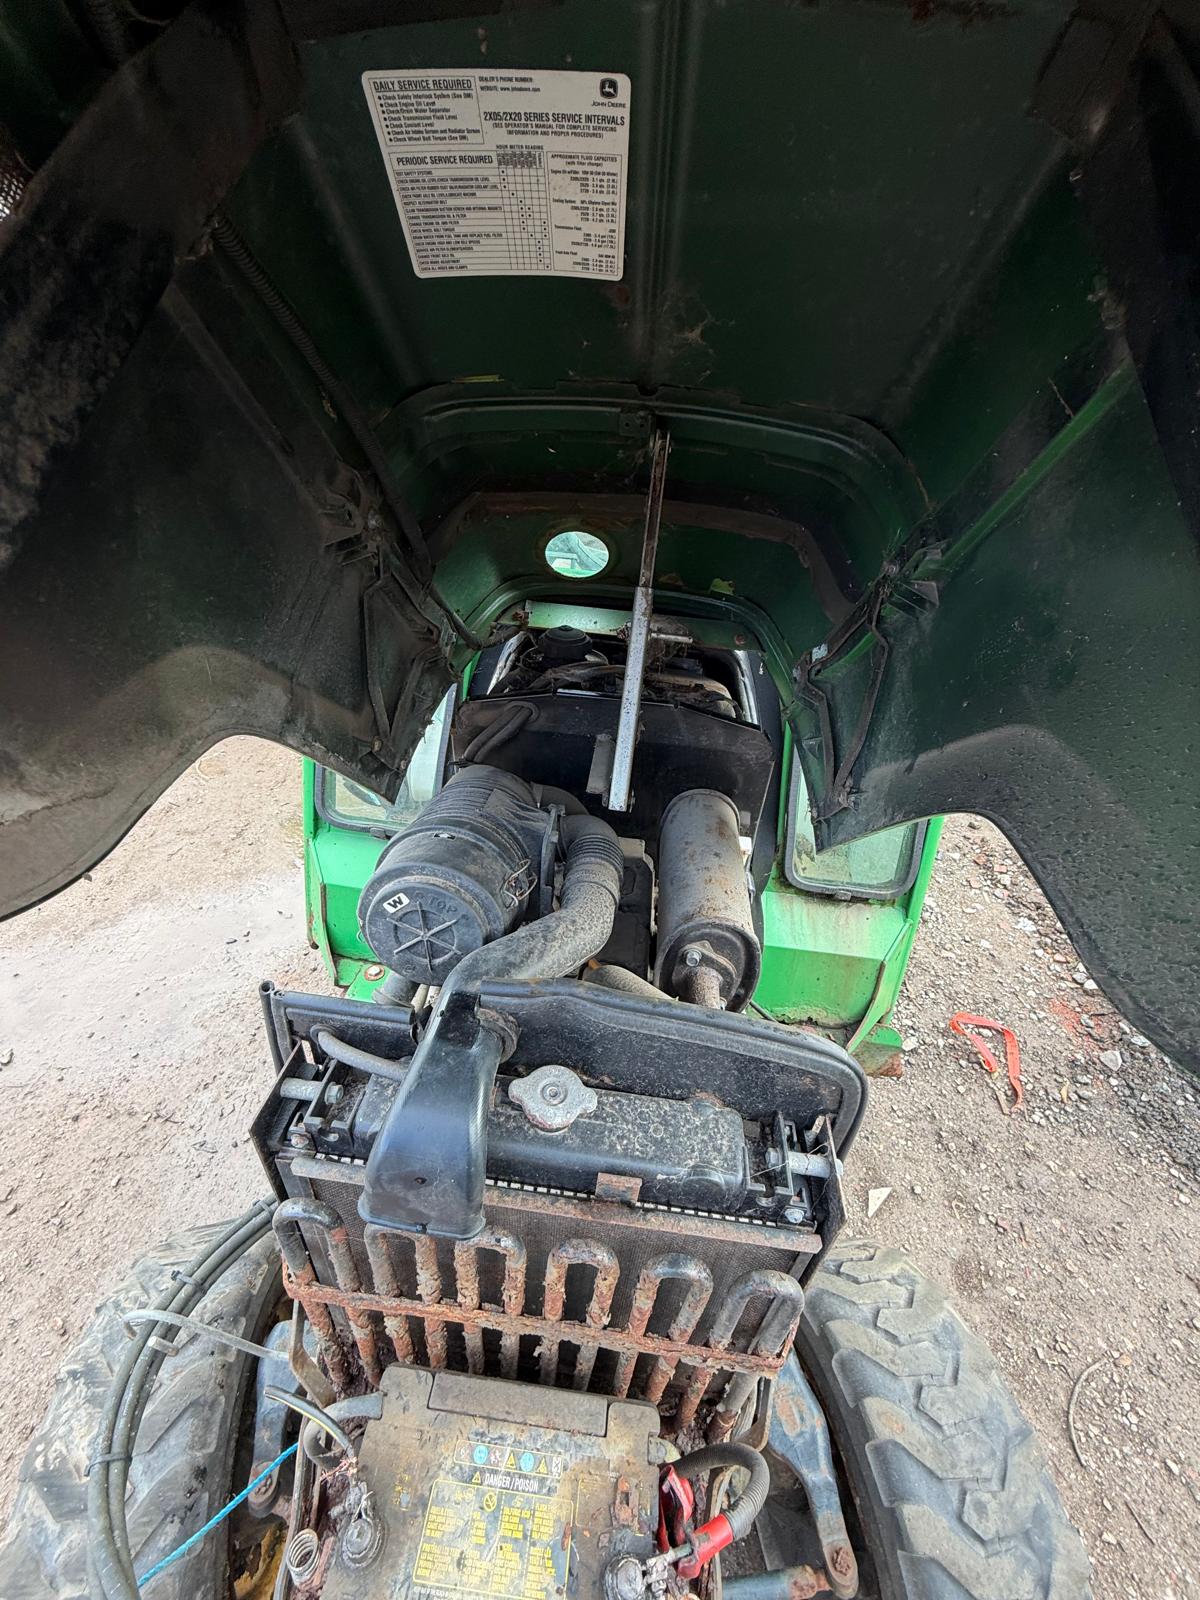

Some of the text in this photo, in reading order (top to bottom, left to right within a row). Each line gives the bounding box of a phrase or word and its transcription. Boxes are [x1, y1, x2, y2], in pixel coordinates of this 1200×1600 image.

[373, 79, 472, 91] DAILY SERVICE REQUIRED
[484, 112, 625, 125] 2X05/2X20 SERIES SERVICE INTERVALS
[397, 157, 428, 165] PERIODIC
[430, 156, 457, 164] SERVICE
[459, 156, 493, 164] REQUIRED
[388, 896, 403, 909] W
